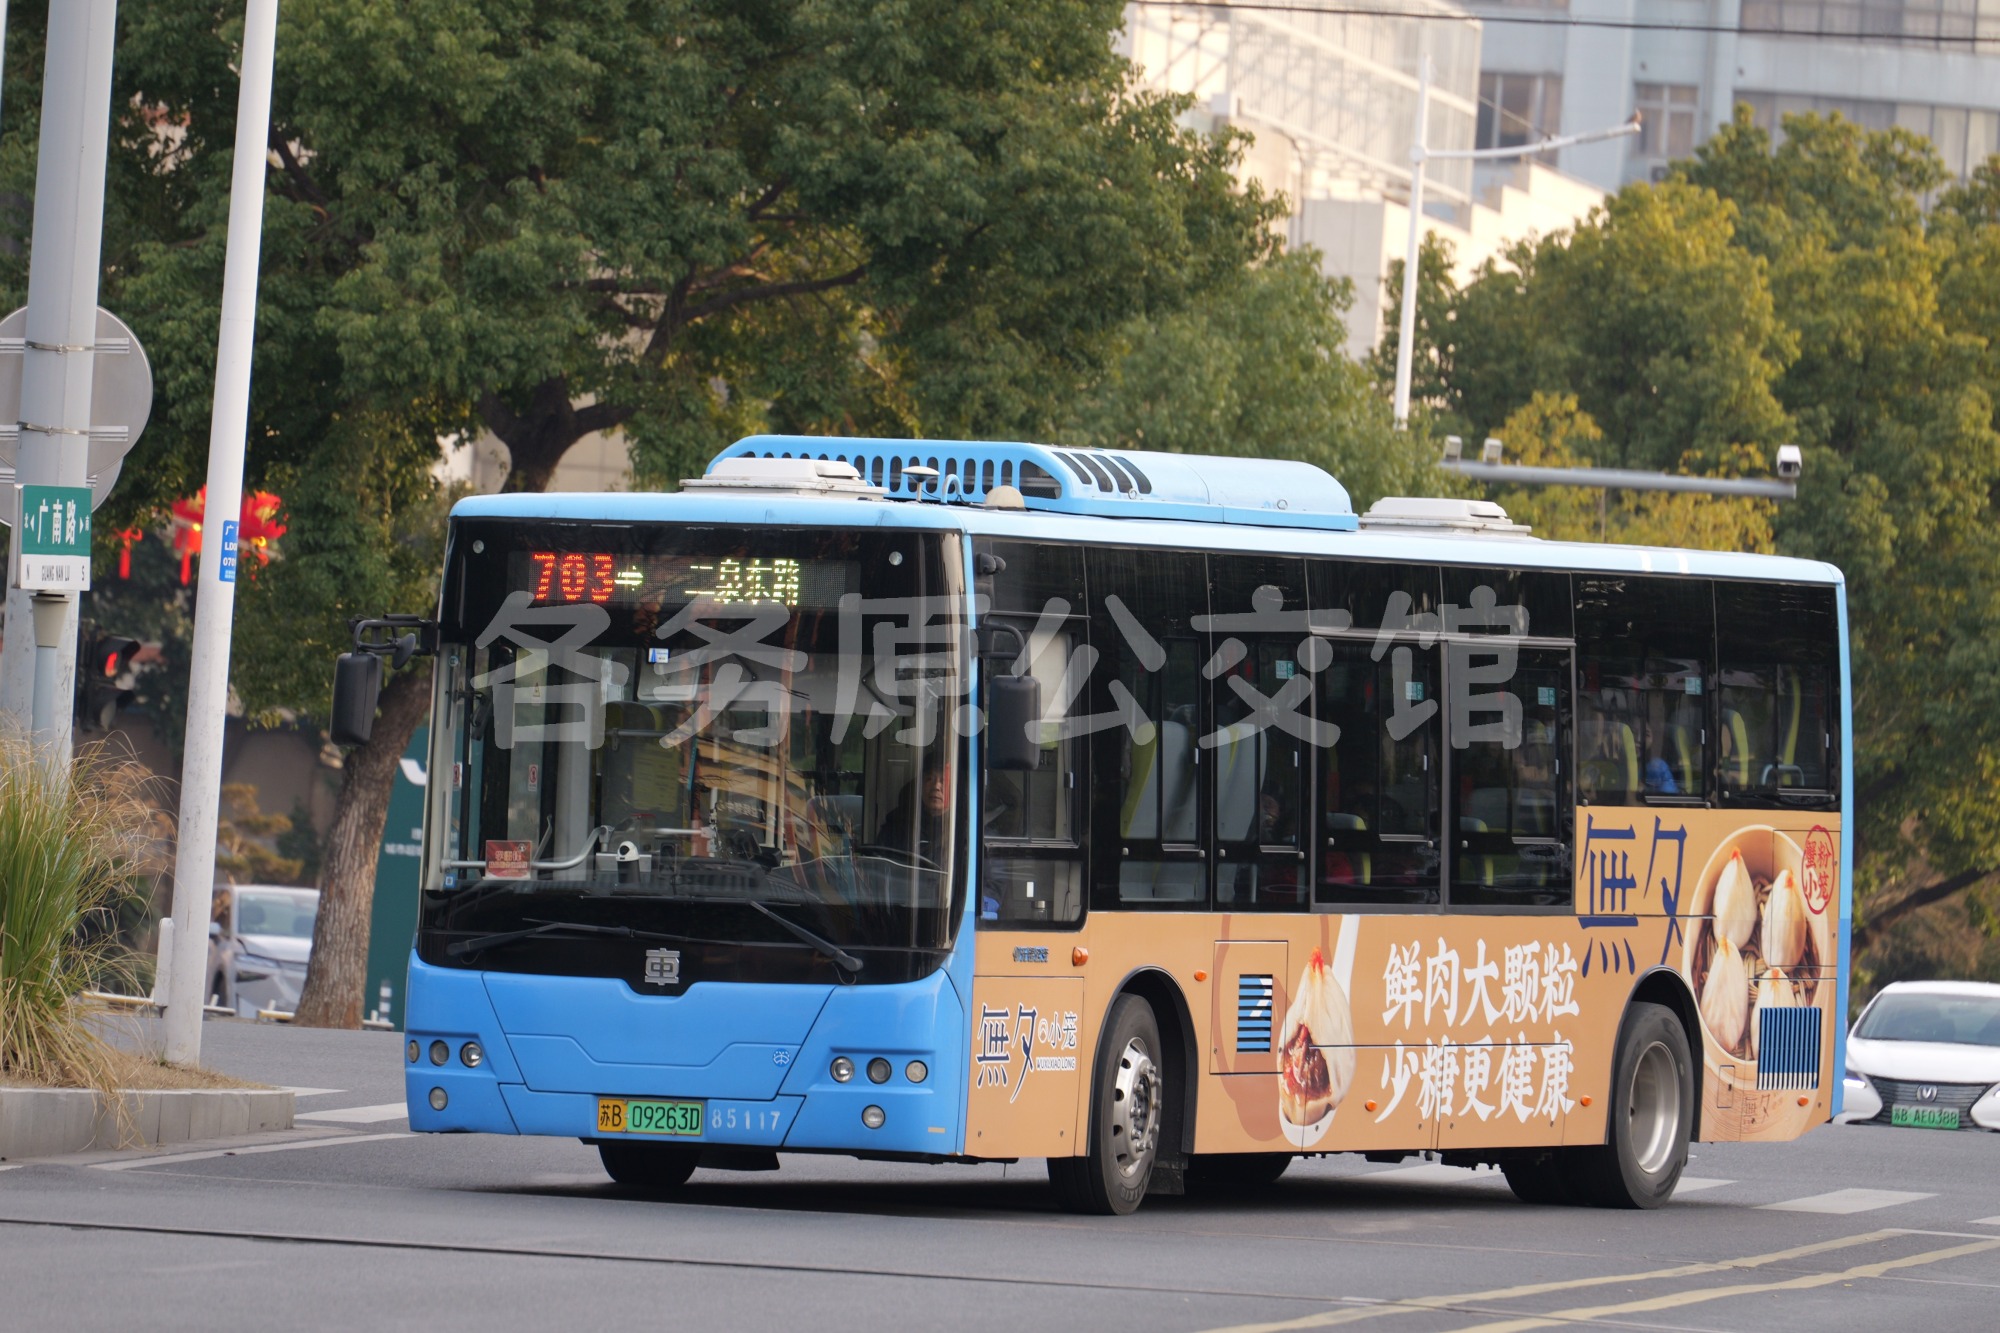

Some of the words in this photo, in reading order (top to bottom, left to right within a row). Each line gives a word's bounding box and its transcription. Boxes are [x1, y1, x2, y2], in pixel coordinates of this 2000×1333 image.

[37, 497, 77, 546] 广南路
[26, 564, 30, 580] N
[41, 565, 54, 582] GUANG
[55, 565, 64, 582] NAN
[64, 565, 71, 582] LU
[81, 565, 85, 582] S
[532, 553, 613, 601] 703
[1382, 936, 1580, 1030] 鲜肉大颗粒
[1048, 1011, 1077, 1049] 小笼
[1375, 1029, 1575, 1123] 少糖更健康
[600, 1104, 622, 1127] 苏B
[632, 1105, 700, 1131] 09263D
[711, 1108, 781, 1132] 85117
